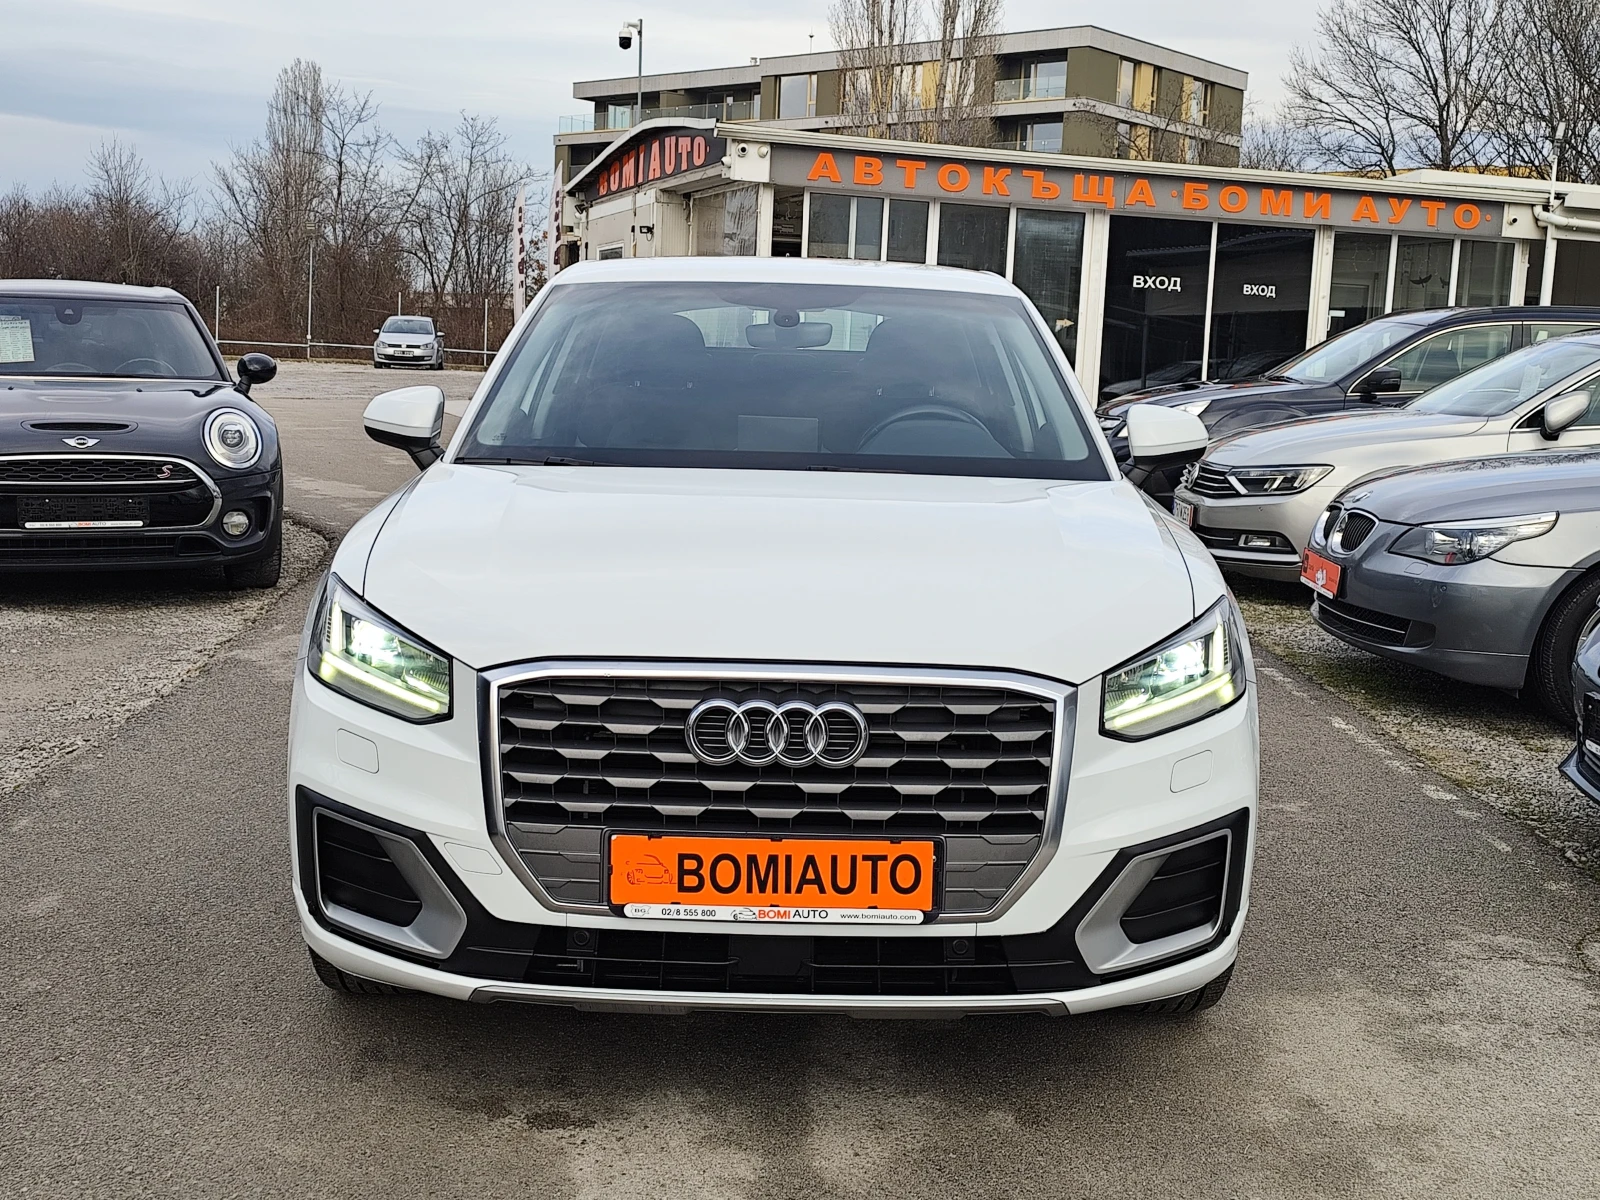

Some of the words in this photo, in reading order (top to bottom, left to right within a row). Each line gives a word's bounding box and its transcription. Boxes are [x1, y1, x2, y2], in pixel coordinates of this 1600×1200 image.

[807, 152, 1156, 209] АВТОКЪЩА
[1182, 182, 1332, 220] БОМИ
[1352, 195, 1481, 230] АУТО
[1132, 275, 1181, 292] ВХОД
[1243, 284, 1276, 298] ВХОД
[677, 853, 922, 896] BOMIAUTO
[661, 908, 681, 917] 02/8
[683, 909, 699, 917] 555
[701, 909, 717, 918] 800
[758, 909, 791, 920] BOMI
[792, 909, 829, 920] AUTO
[840, 912, 917, 921] www.bomiauto.com
